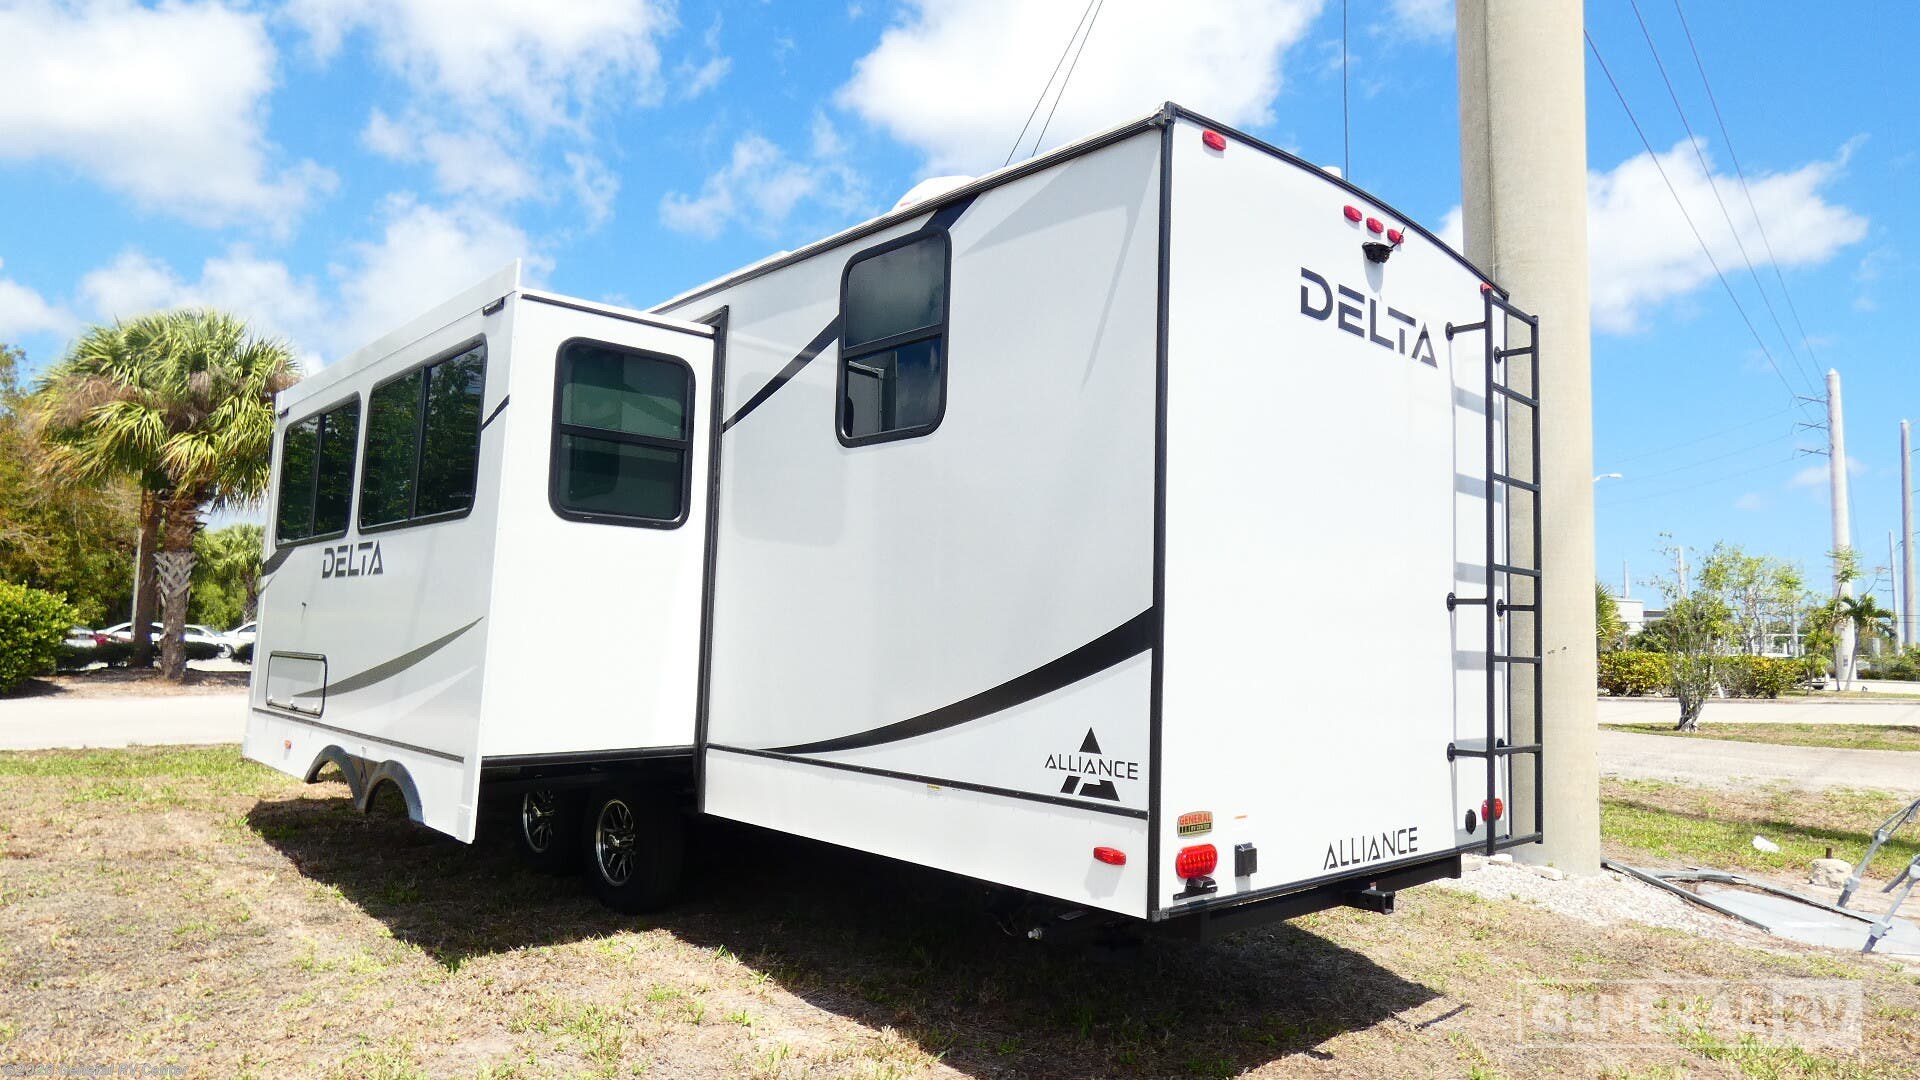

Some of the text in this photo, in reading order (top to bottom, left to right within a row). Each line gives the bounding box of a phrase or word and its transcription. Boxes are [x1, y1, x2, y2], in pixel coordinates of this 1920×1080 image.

[1300, 266, 1438, 368] DELTA
[322, 540, 384, 579] DELTA
[1044, 753, 1138, 780] ALLIANCE
[1180, 813, 1212, 825] GENERAL
[1323, 827, 1418, 870] ALLIANCE
